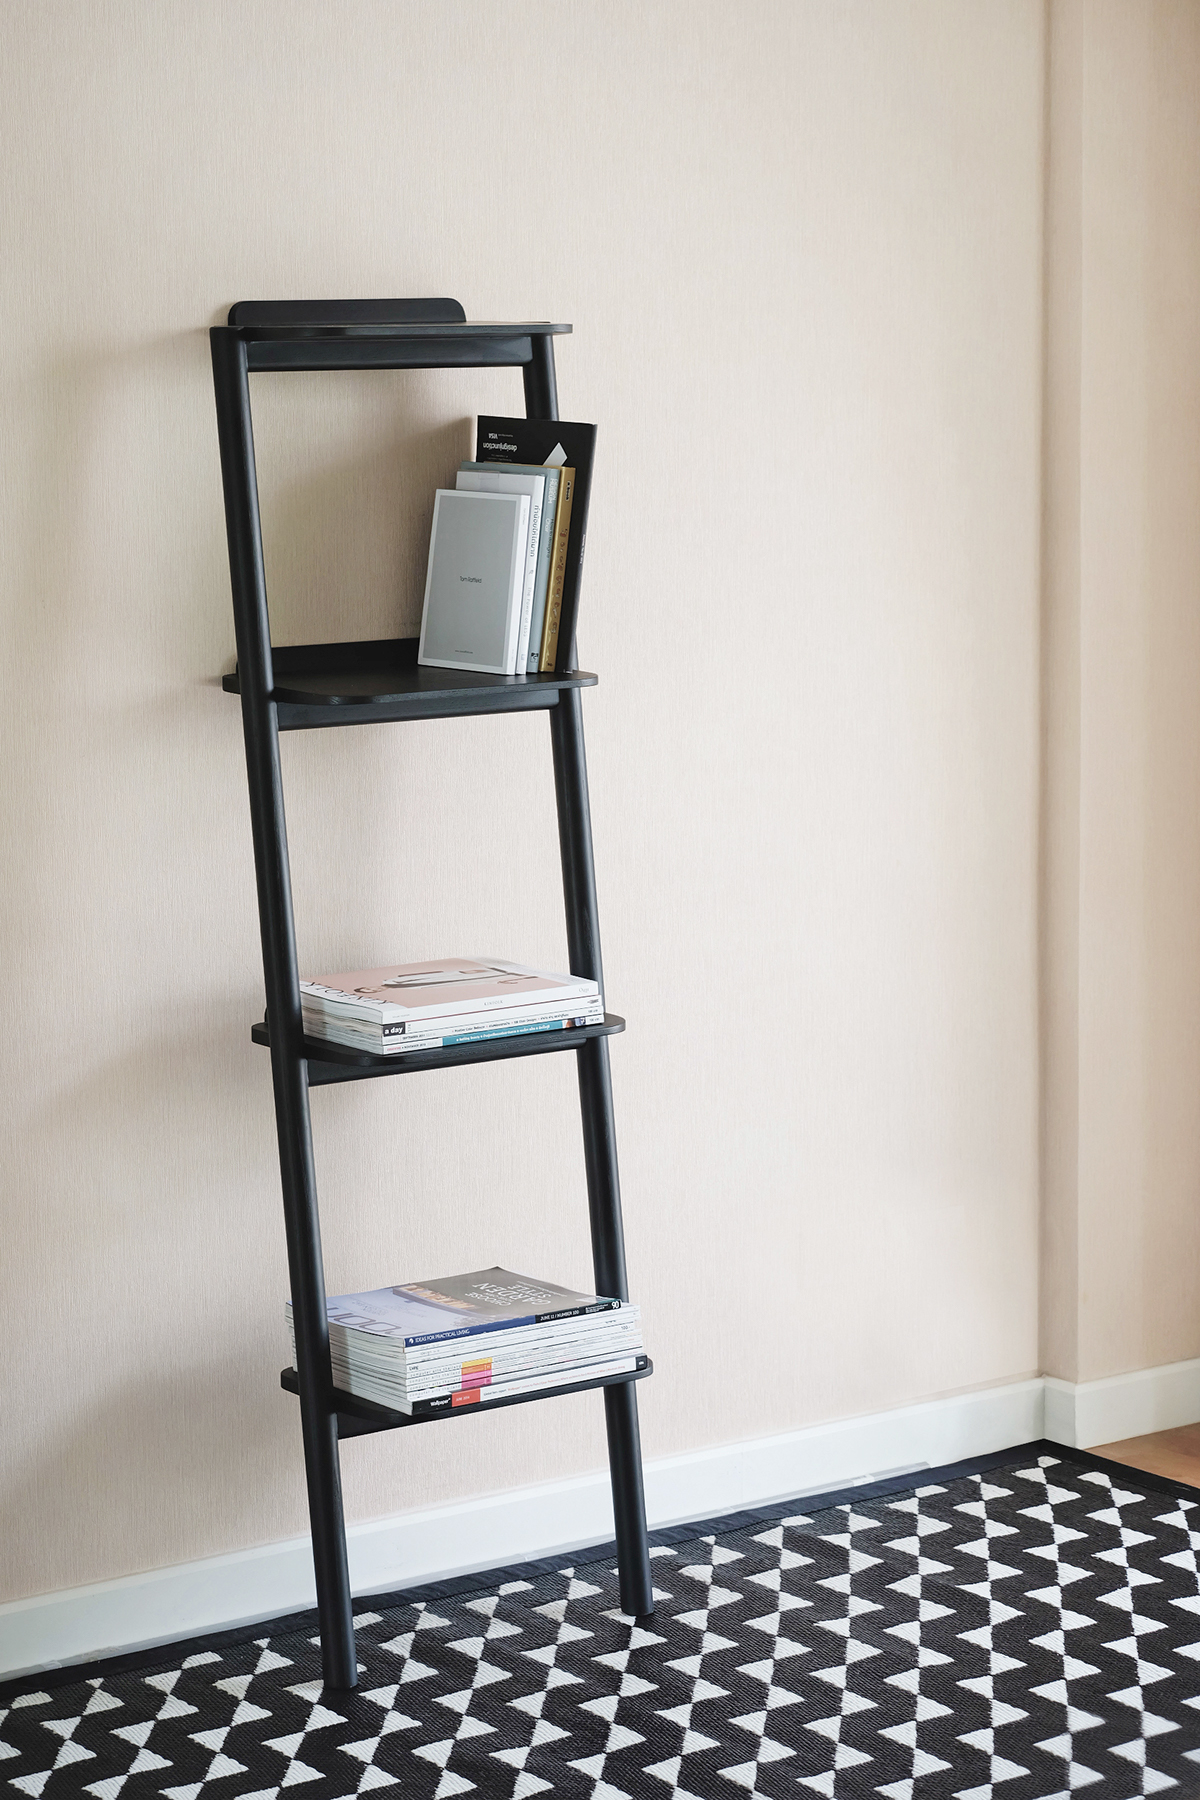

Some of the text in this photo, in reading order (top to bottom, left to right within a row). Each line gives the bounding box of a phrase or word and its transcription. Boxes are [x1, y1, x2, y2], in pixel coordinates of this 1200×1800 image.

[483, 442, 518, 452] designjunction
[390, 1026, 403, 1034] day
[472, 1282, 551, 1305] GARDEN
[507, 1284, 551, 1298] STYLE
[465, 1292, 511, 1306] CHOOSE
[611, 1300, 619, 1309] 90
